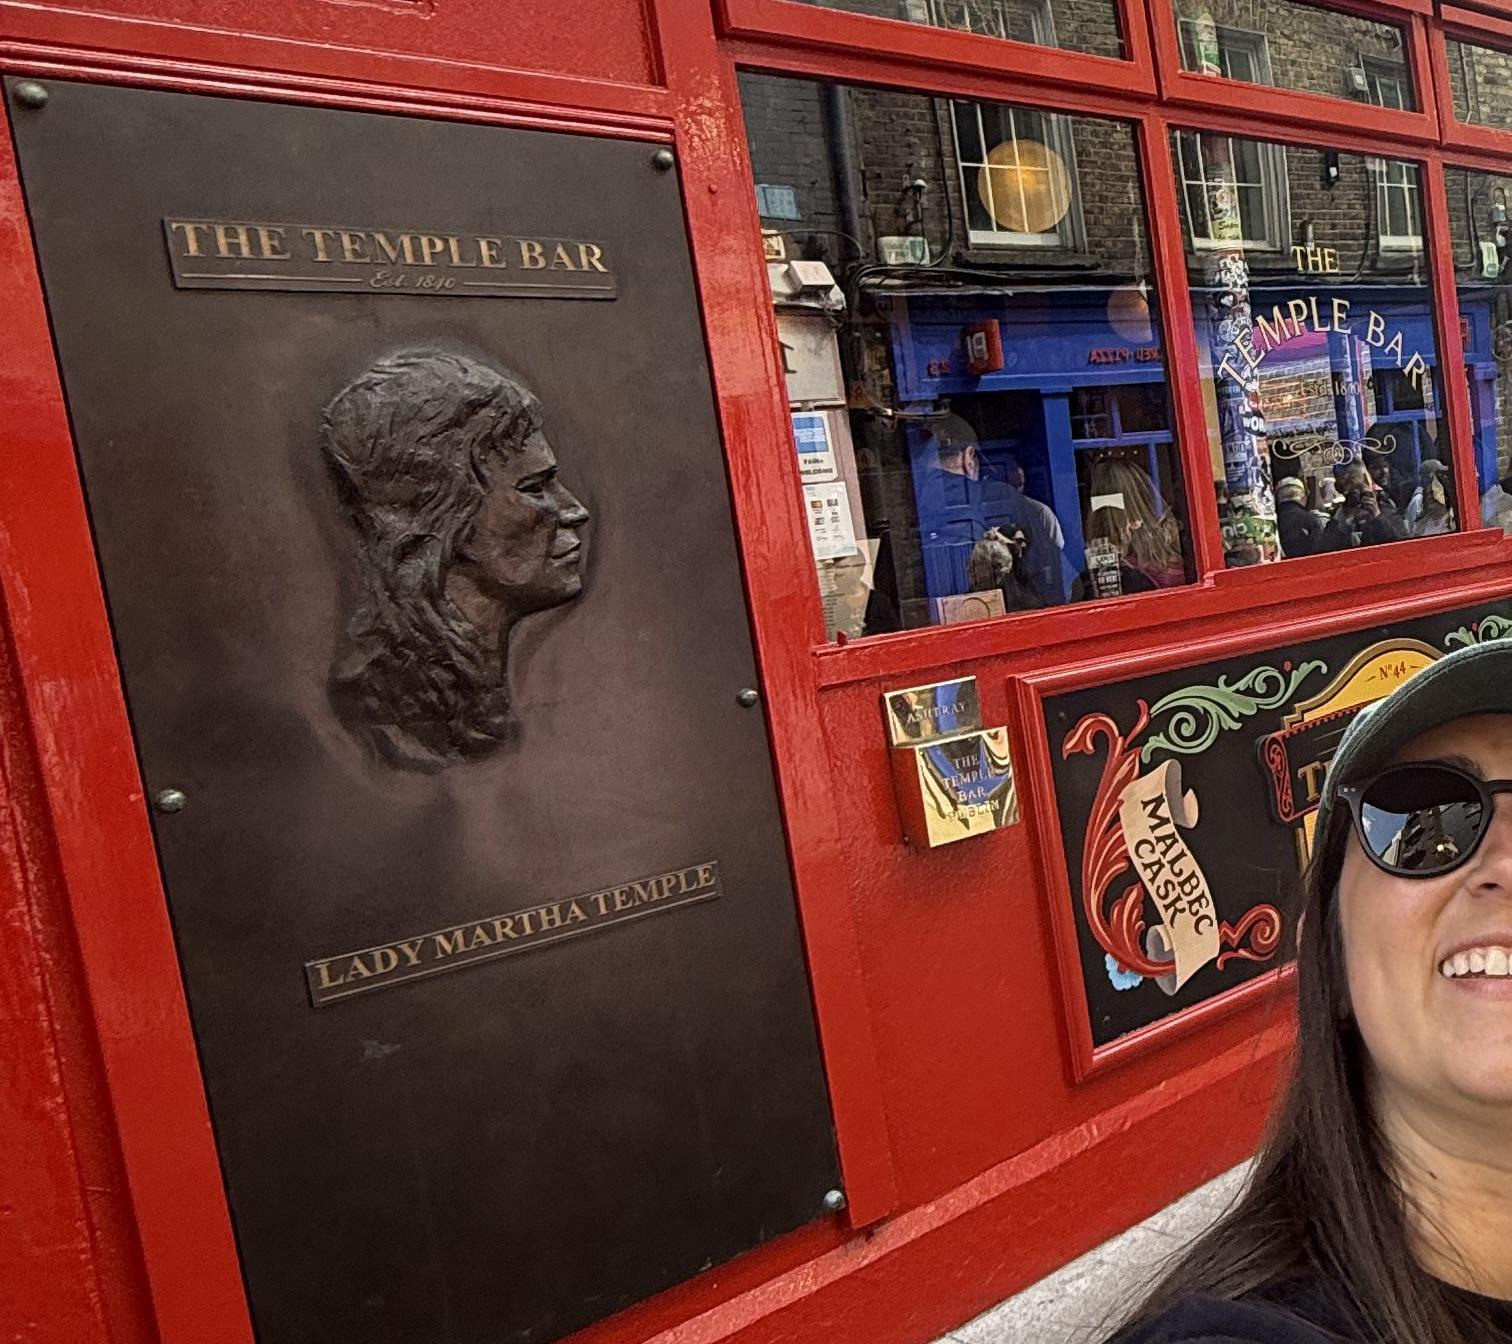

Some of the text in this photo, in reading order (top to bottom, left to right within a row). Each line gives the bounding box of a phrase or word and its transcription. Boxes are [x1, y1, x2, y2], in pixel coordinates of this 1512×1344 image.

[172, 221, 609, 274] THE TEMPLE BAR
[1291, 245, 1340, 274] THE
[415, 274, 457, 291] 1840
[1217, 296, 1428, 391] TEMPLE BAR
[906, 701, 967, 725] ASHTRAY
[953, 755, 981, 771] THE
[956, 785, 987, 803] BAR
[1134, 839, 1187, 930] CASK
[1141, 792, 1214, 936] MALBEC
[314, 862, 718, 989] LADY MARTHA TEMPLE
